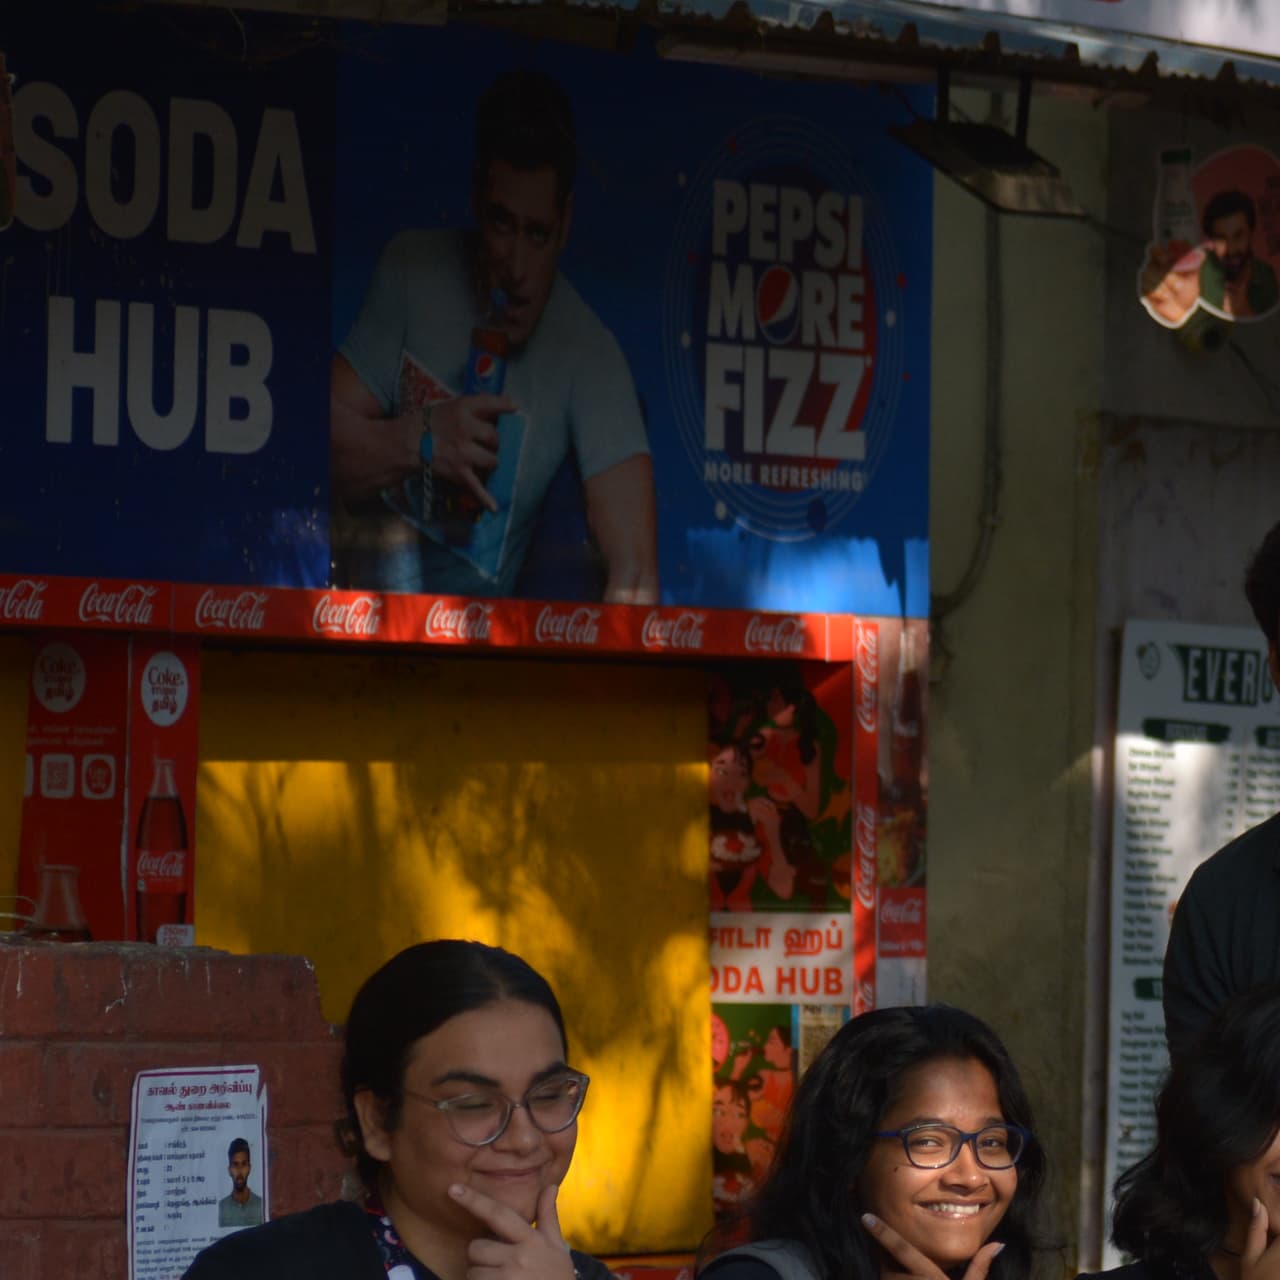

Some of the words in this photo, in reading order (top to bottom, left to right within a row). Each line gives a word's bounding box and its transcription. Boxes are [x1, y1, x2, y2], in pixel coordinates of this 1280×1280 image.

[12, 81, 317, 255] SODA
[711, 178, 863, 271] PEPSI
[45, 295, 273, 455] HUB
[704, 341, 868, 461] FIZZ
[704, 461, 753, 486] MORE
[760, 464, 865, 492] REFRESHING
[777, 967, 843, 995] HUB
